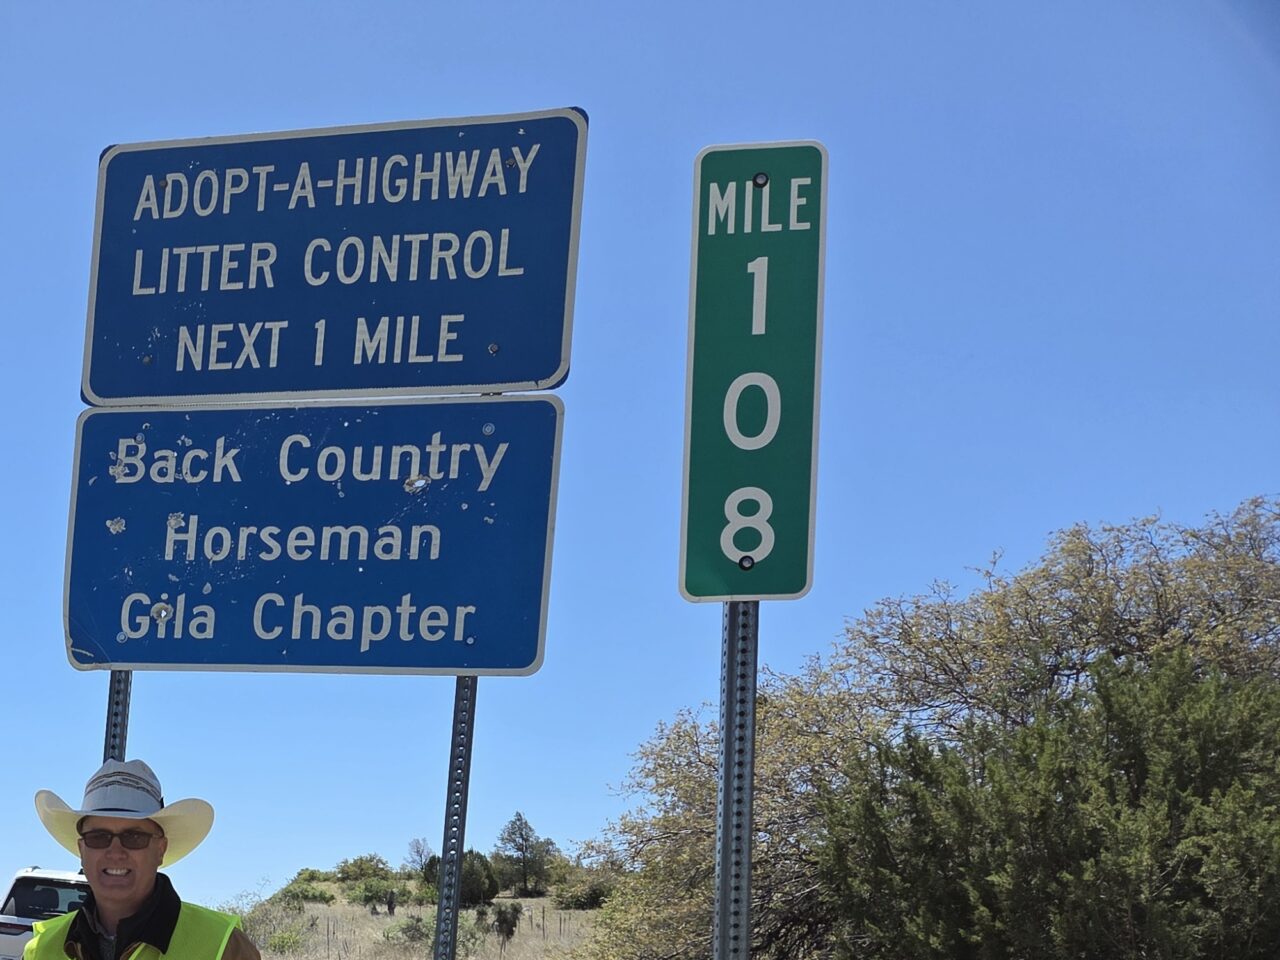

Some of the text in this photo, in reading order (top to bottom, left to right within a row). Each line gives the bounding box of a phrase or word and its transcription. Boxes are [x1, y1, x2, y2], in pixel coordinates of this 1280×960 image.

[133, 143, 541, 221] ADOPT-A-HIGHWAY
[707, 177, 812, 236] MILE
[132, 228, 524, 296] LITTER CONTROL
[176, 314, 465, 372] NEXT 1 MILE
[719, 256, 781, 565] 108
[115, 431, 509, 492] Back Country
[164, 514, 441, 561] Horseman
[121, 592, 476, 653] Gila Chapter
